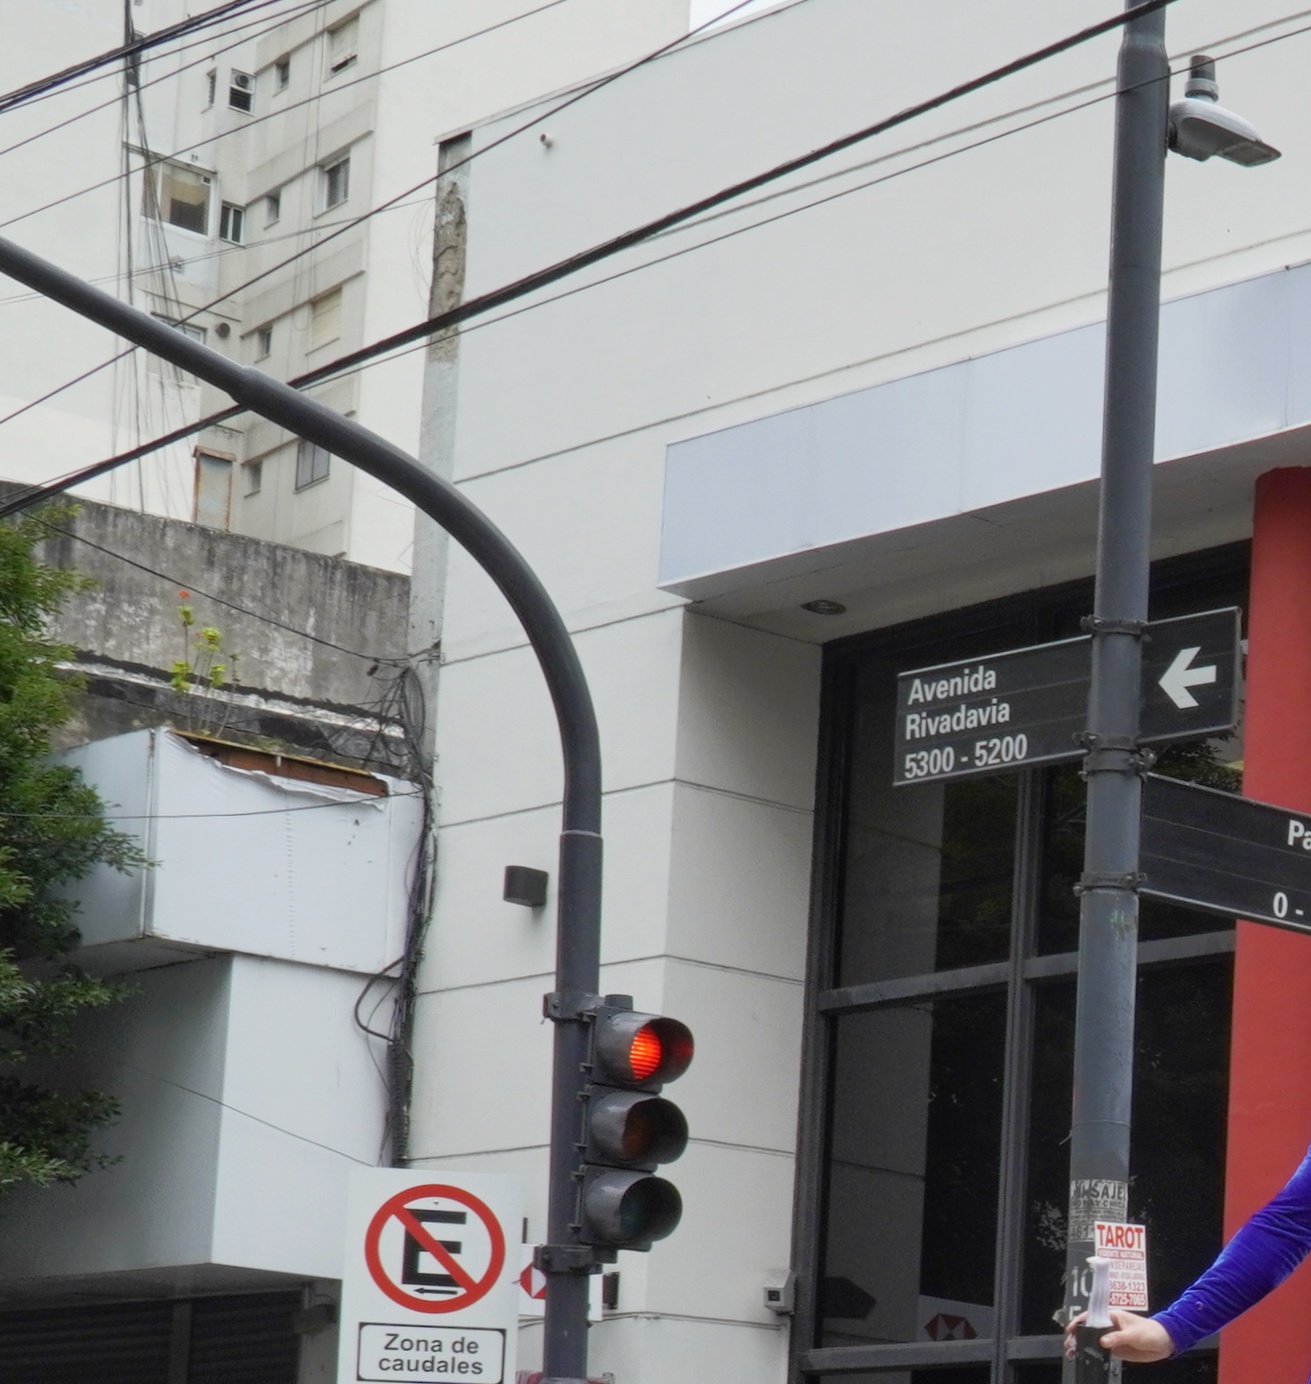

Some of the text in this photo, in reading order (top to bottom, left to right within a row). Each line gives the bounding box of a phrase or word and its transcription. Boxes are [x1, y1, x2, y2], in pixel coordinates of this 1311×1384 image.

[907, 665, 997, 705] Avenida
[905, 698, 1011, 740] Rivadavia
[904, 746, 954, 778] 5300
[974, 733, 1028, 767] 5200
[1273, 892, 1288, 918] 0
[1096, 1224, 1144, 1249] TAROT
[384, 1332, 479, 1354] Zona de
[378, 1355, 484, 1375] caudales
